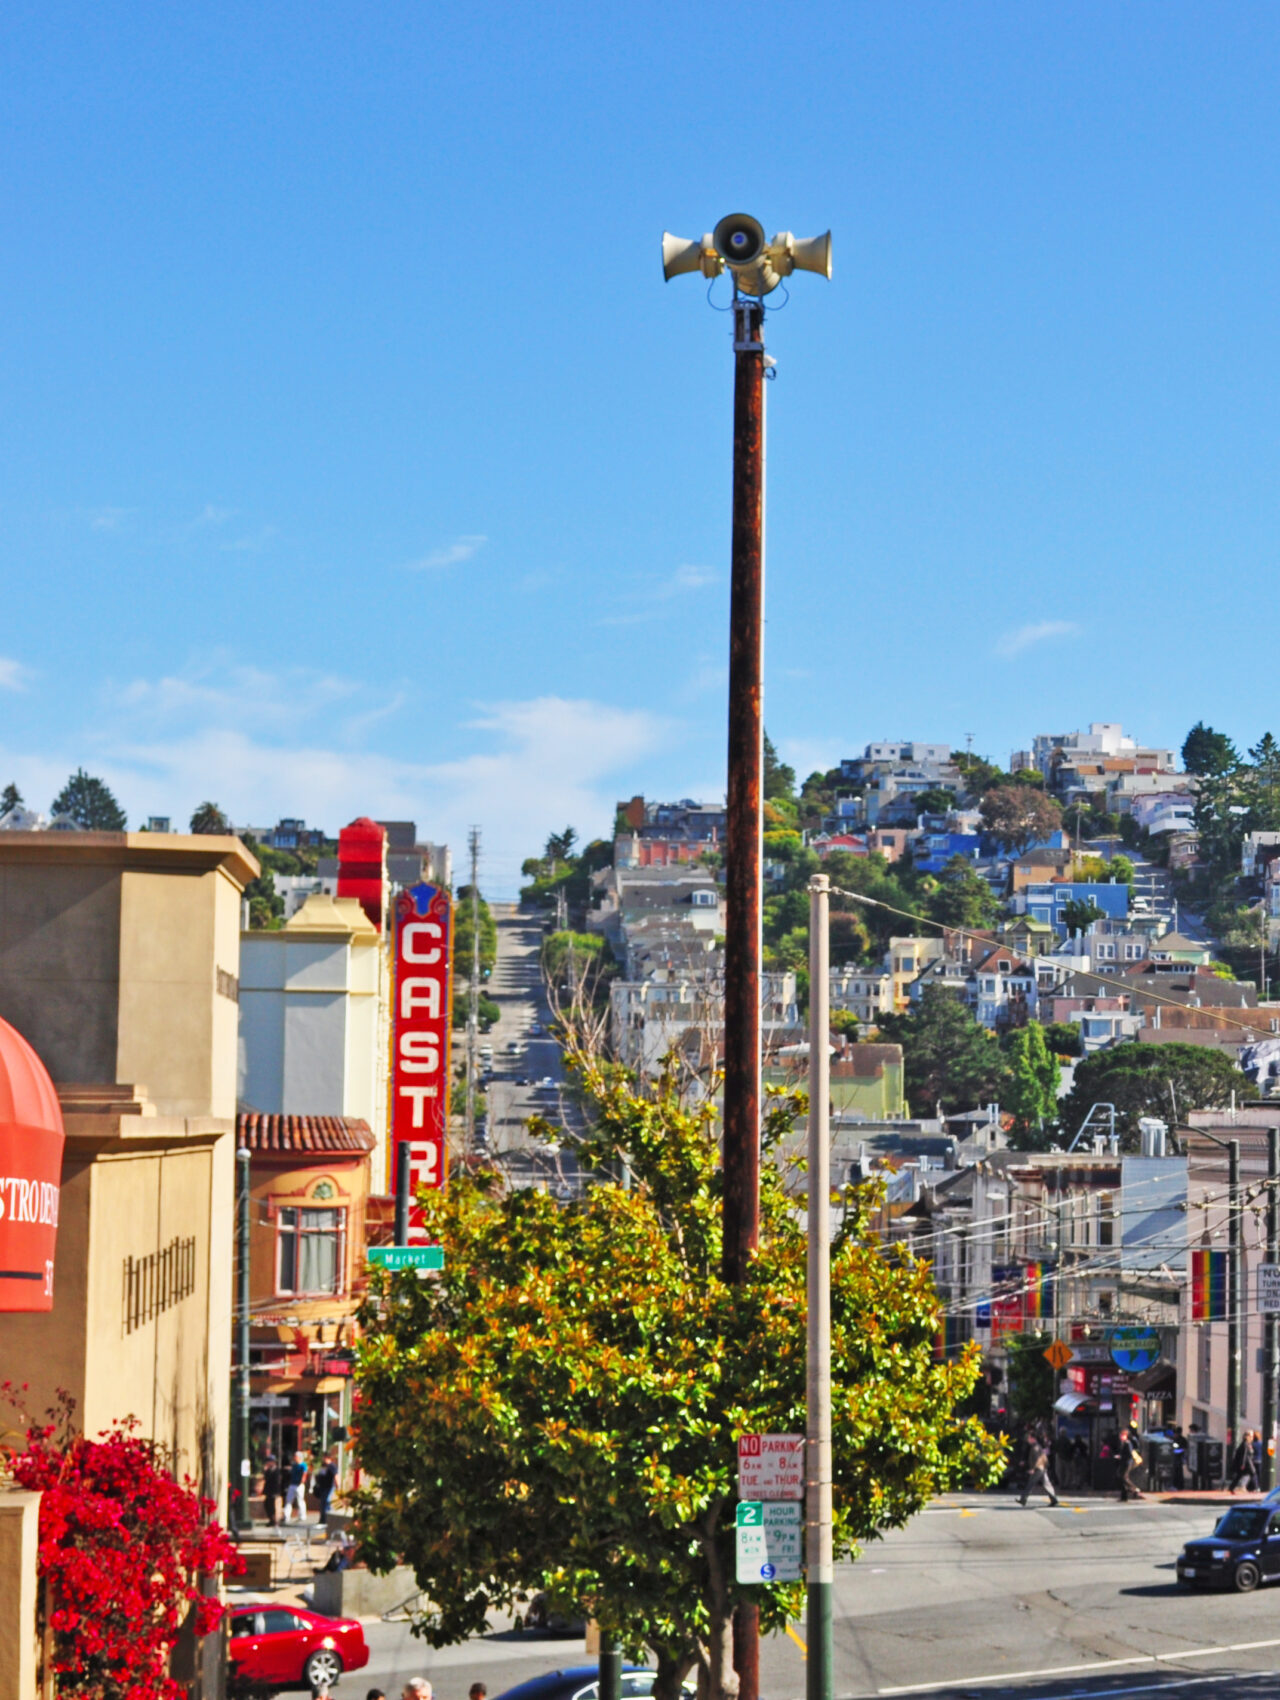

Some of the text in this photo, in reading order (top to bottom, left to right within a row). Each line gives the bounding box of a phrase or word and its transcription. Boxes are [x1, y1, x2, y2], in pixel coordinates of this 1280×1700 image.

[385, 1254, 426, 1265] Market
[1263, 1268, 1280, 1278] NO
[1266, 1289, 1279, 1298] ON
[1263, 1299, 1280, 1308] RED
[1146, 1390, 1173, 1400] PIZZA
[740, 1435, 801, 1455] NO PARKING
[743, 1506, 795, 1524] 2 HOUR
